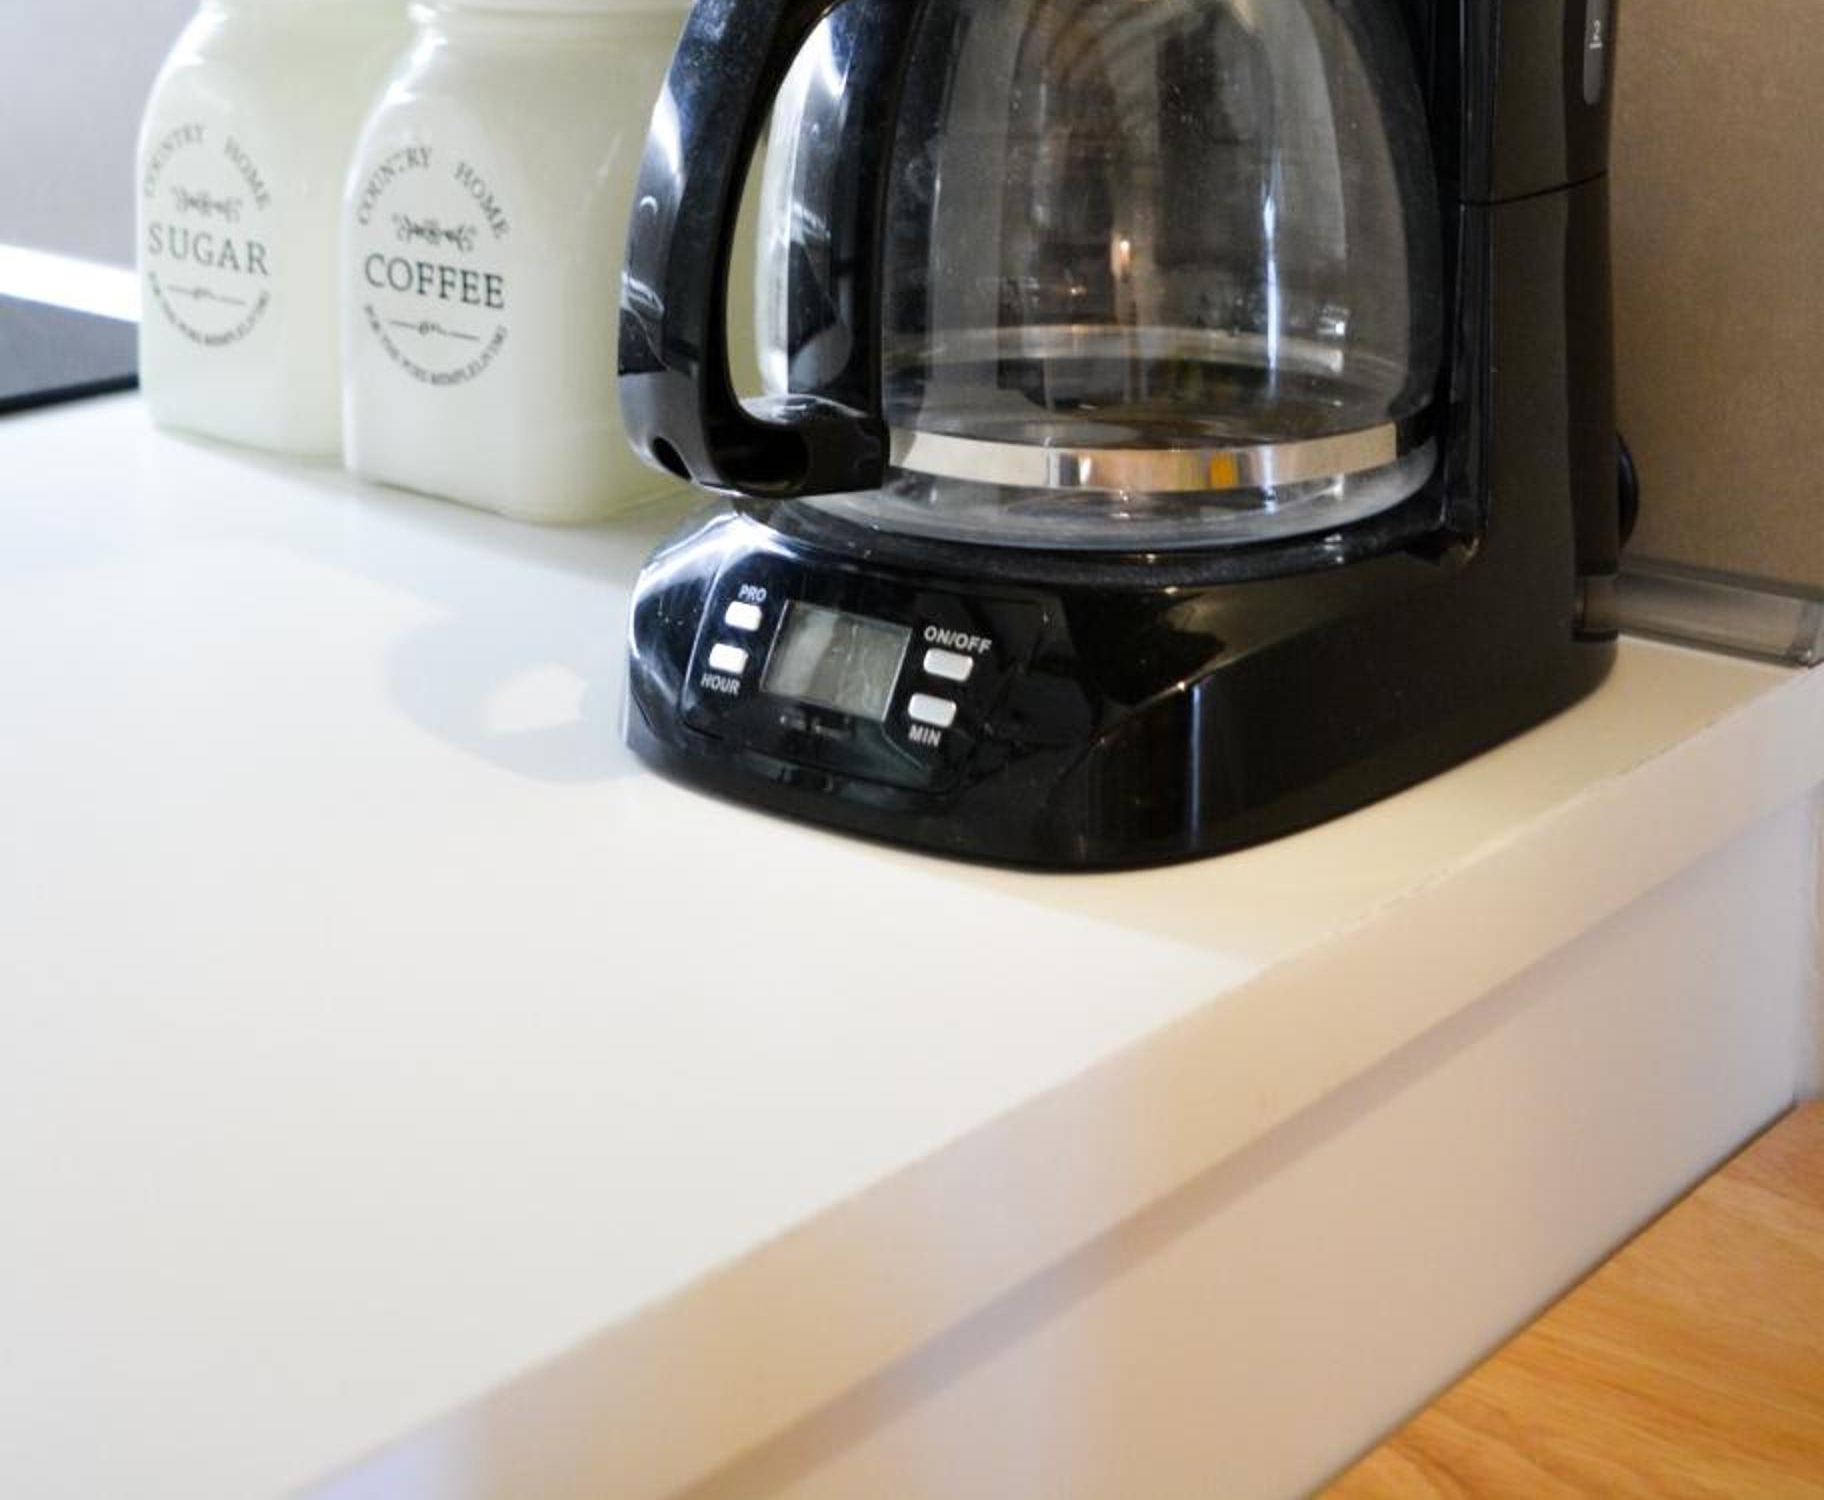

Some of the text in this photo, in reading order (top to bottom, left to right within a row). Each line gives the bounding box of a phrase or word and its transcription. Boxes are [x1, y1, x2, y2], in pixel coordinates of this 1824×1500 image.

[453, 161, 511, 241] HOME
[148, 221, 269, 277] SUGAR
[364, 253, 505, 309] COFFEE
[738, 583, 767, 602] PRO
[923, 625, 992, 655] ON/OFF
[700, 672, 741, 695] HOUR
[907, 723, 942, 748] MIN
